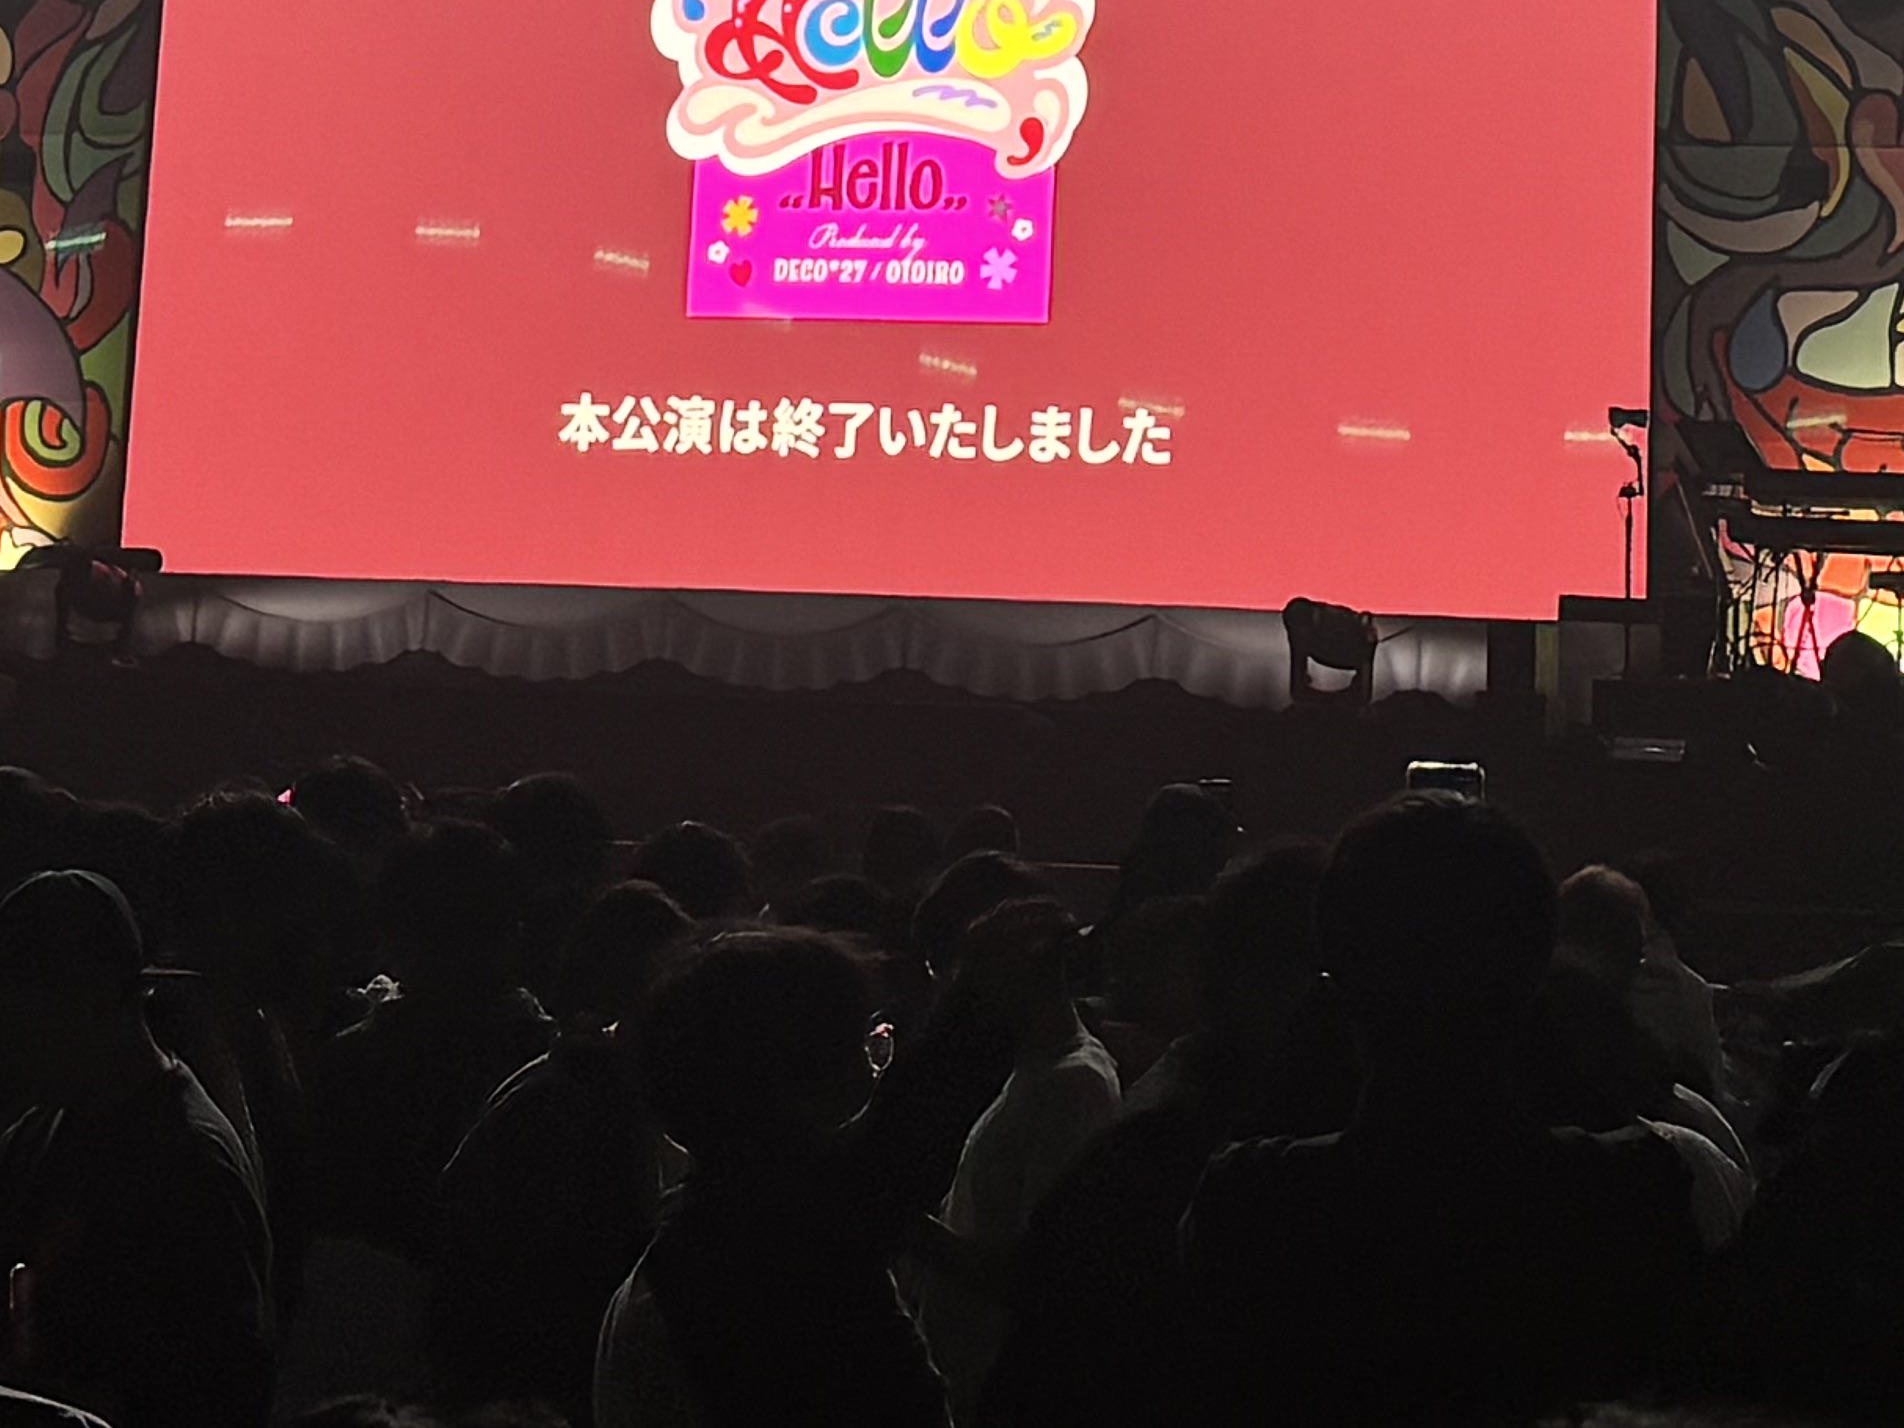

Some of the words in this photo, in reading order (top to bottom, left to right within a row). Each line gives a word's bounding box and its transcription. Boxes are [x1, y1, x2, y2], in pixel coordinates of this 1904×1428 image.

[558, 392, 1172, 466] 本公演は終了いたしました
